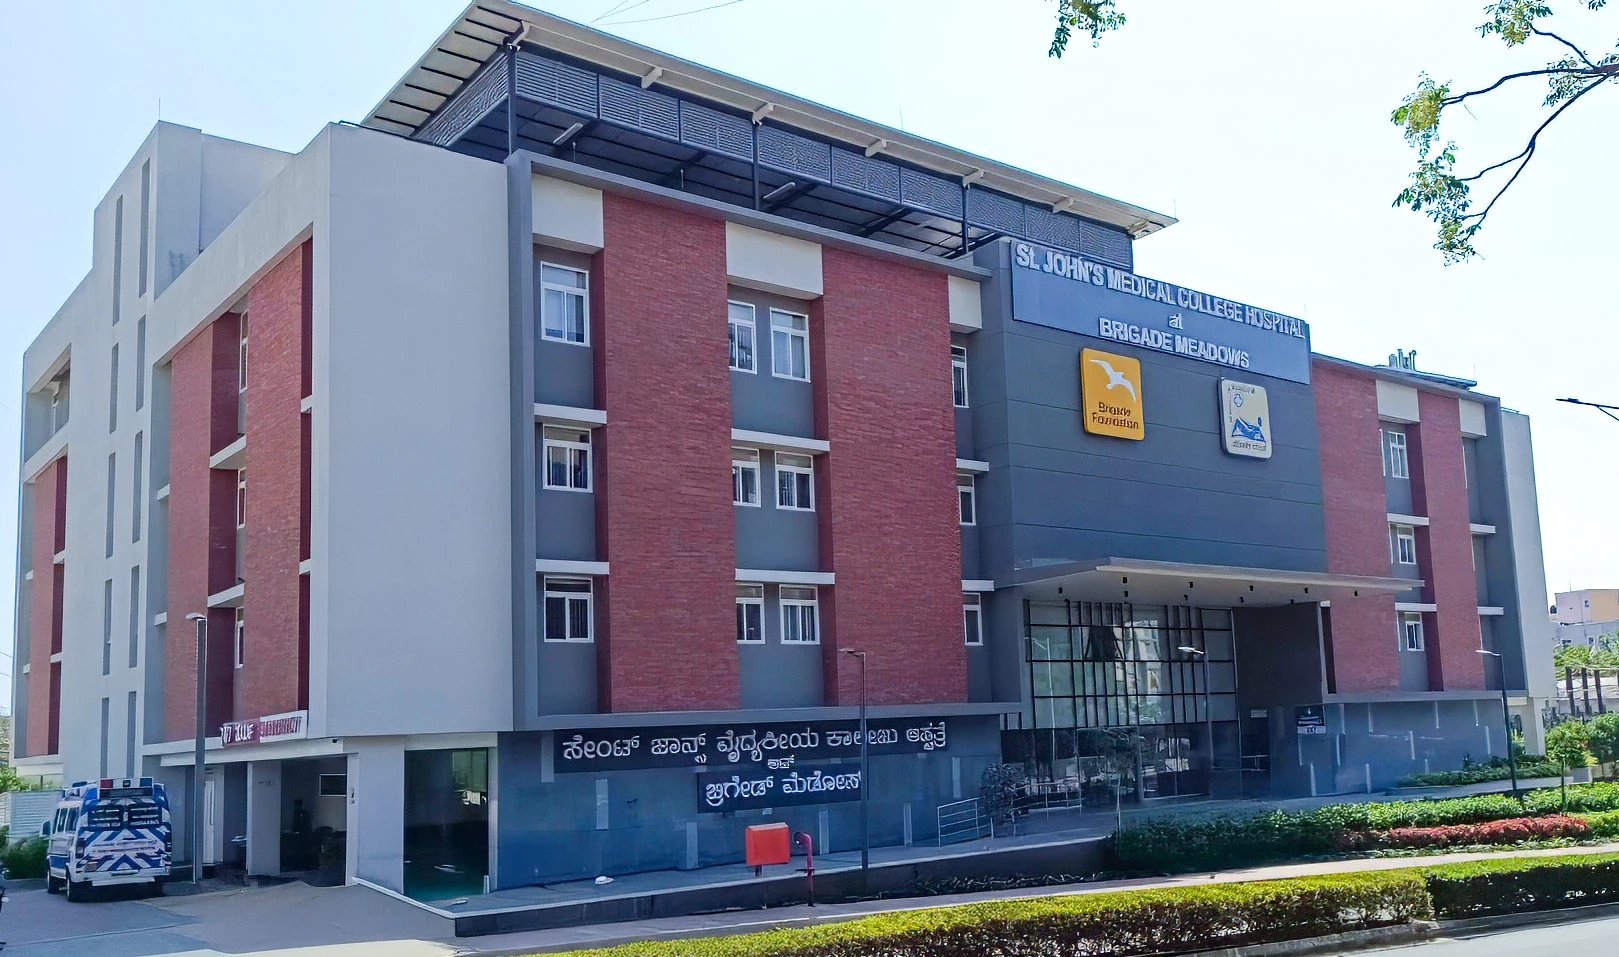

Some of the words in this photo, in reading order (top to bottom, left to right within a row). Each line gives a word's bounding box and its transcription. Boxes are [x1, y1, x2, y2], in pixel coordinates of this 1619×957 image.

[1042, 250, 1105, 286] JOHN'S
[1106, 266, 1177, 305] MEDICAL
[1177, 286, 1244, 323] COLLEGE
[1245, 304, 1306, 339] HOSPITAL
[1099, 317, 1174, 352] BRIGADE
[1174, 334, 1250, 369] MEADOWS
[562, 734, 641, 760] ಸೇಂಟ್
[651, 732, 708, 764] ಜಾನ್ಸ್
[716, 727, 820, 763] ವೈದ್ಯಕೀಯ
